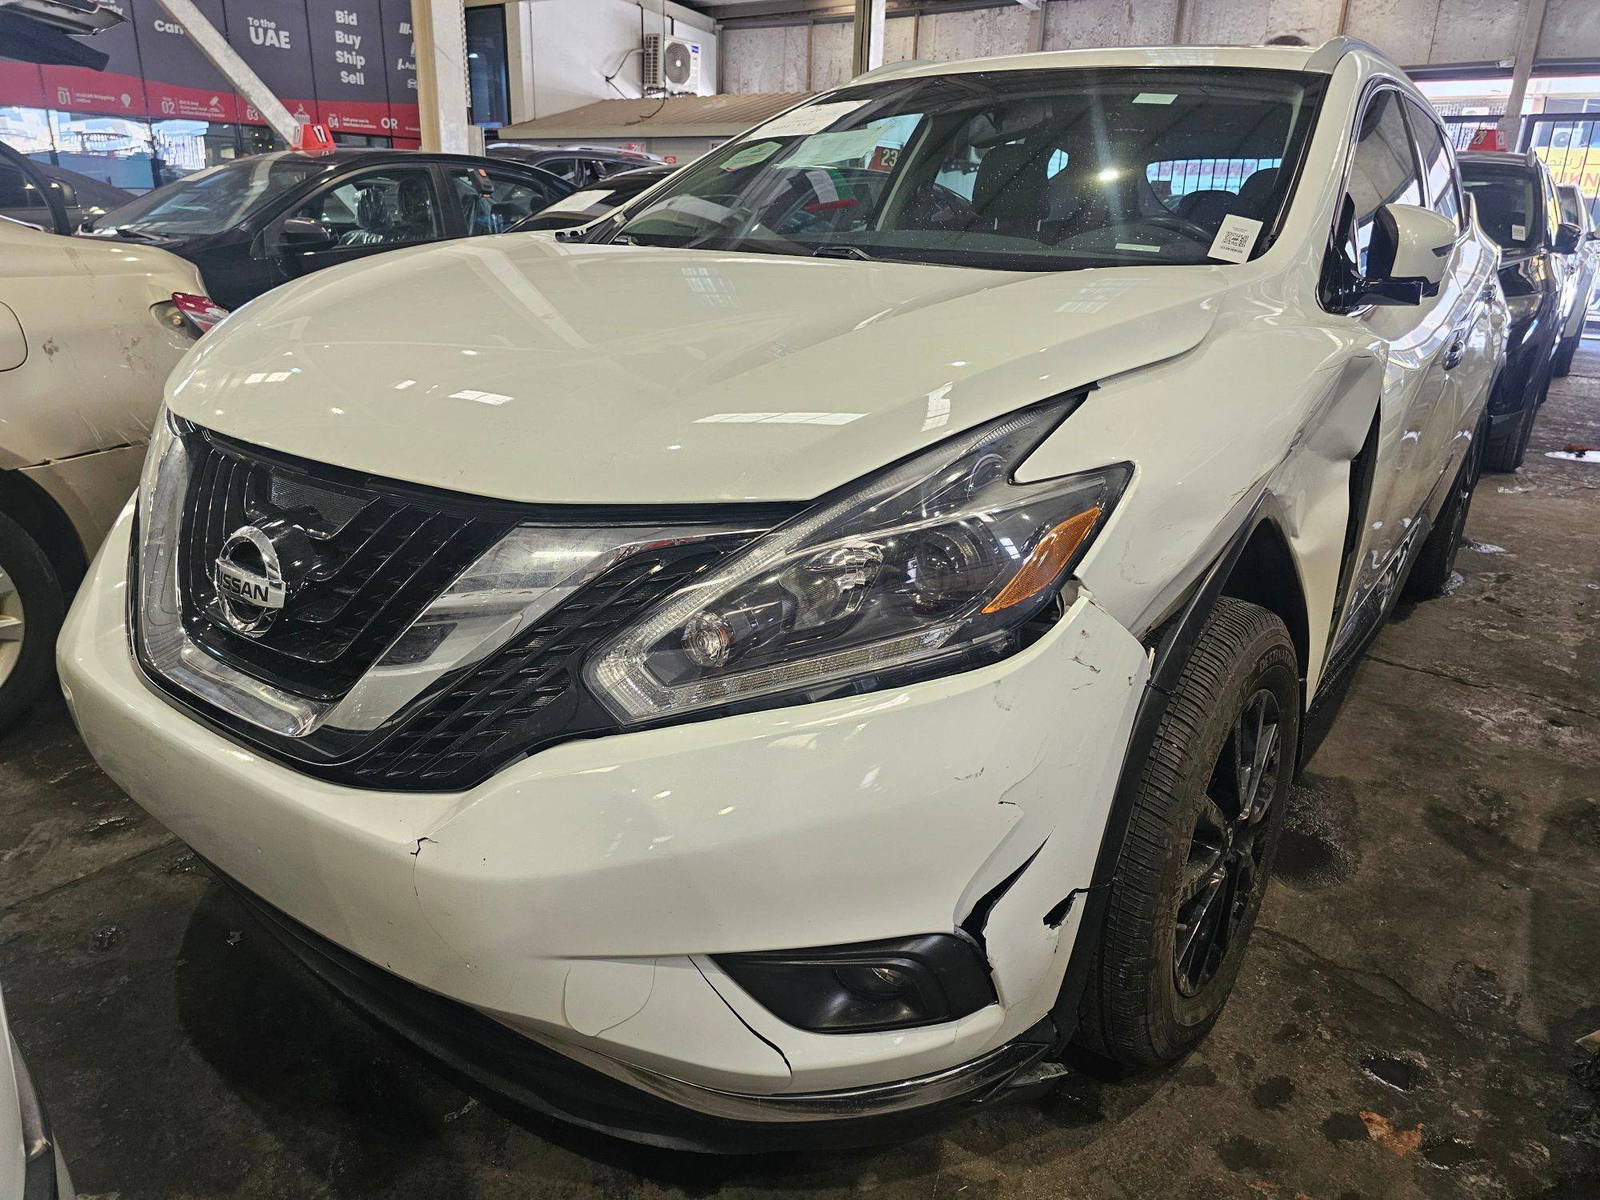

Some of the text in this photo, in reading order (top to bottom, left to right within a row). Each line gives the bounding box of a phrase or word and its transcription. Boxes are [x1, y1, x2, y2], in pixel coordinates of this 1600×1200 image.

[247, 17, 276, 29] To the
[335, 10, 358, 26] Bid
[249, 26, 291, 49] UAE
[335, 30, 361, 49] Buy
[335, 50, 366, 69] Ship
[340, 70, 365, 86] Sell
[161, 101, 177, 115] 02
[327, 116, 339, 129] 04
[380, 117, 399, 130] OR
[313, 125, 328, 143] 17
[880, 149, 899, 167] 23
